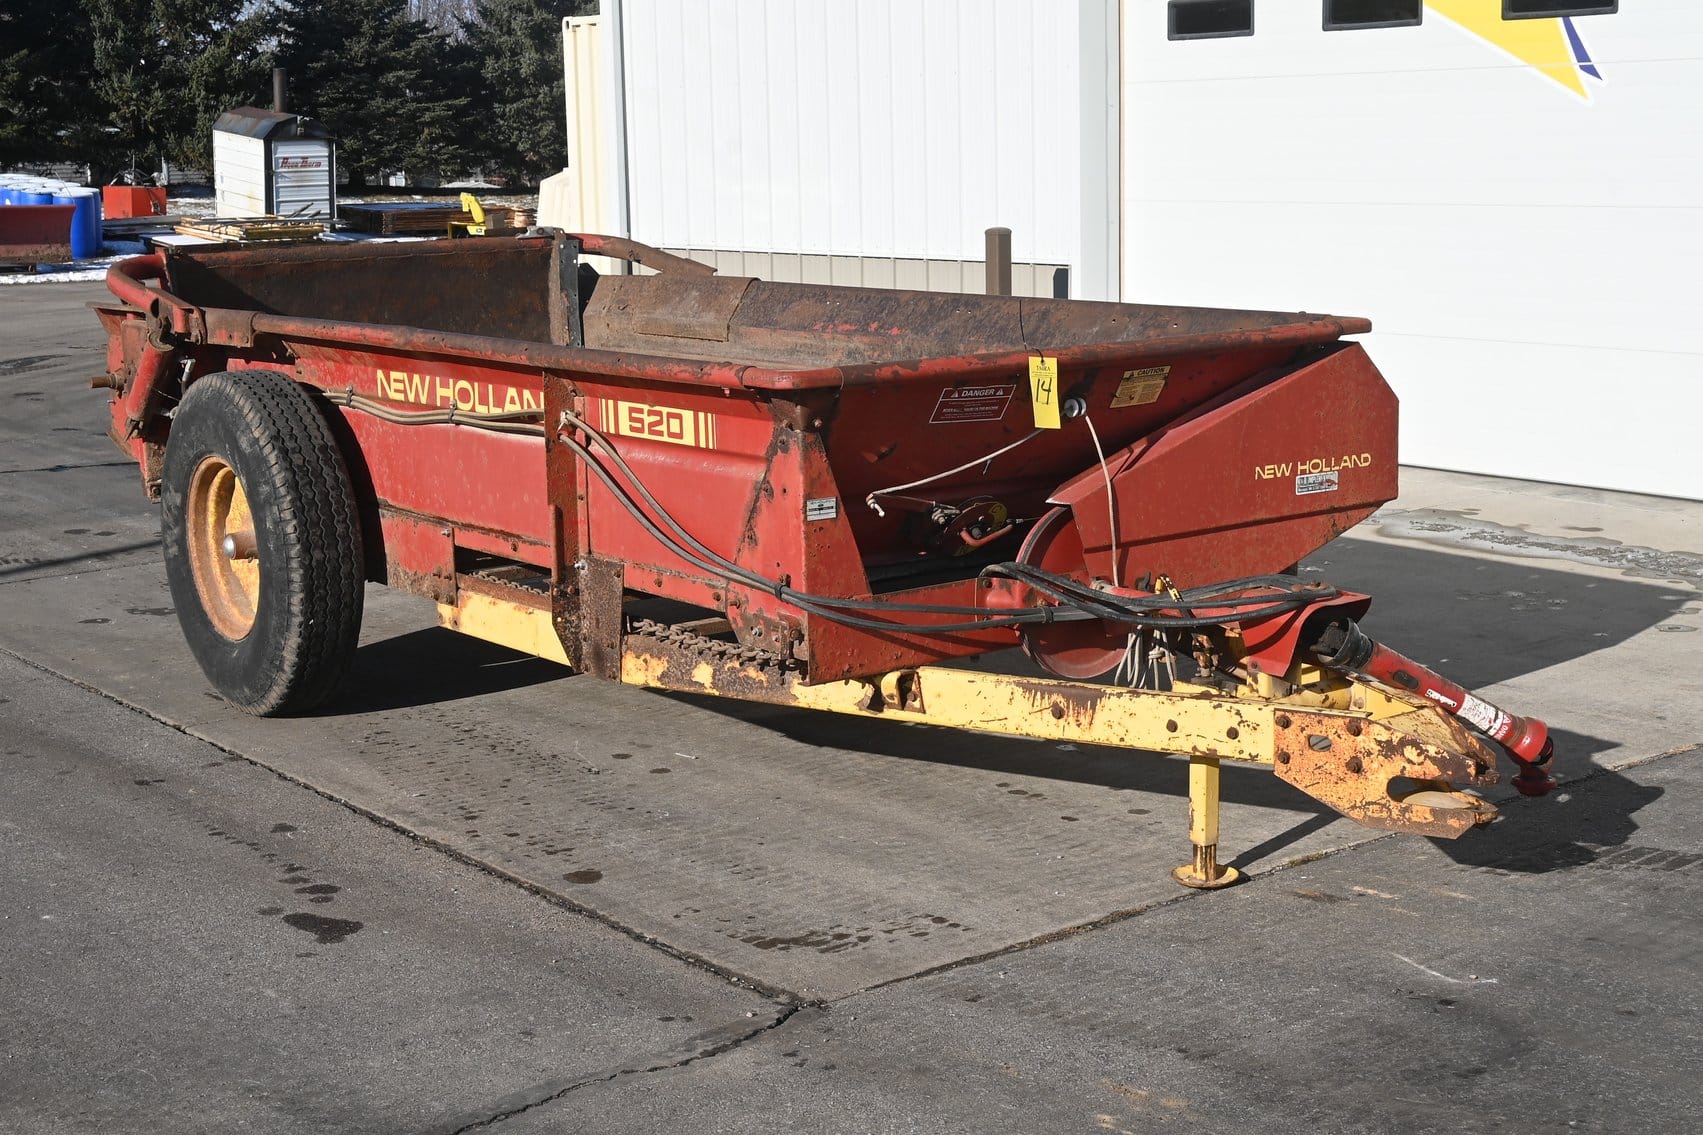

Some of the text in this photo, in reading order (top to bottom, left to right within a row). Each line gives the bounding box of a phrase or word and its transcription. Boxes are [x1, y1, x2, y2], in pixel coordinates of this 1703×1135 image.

[376, 369, 545, 415] NEW HOLLAN
[961, 388, 996, 397] DANGER
[1036, 377, 1052, 405] 14
[627, 406, 684, 440] 520
[1255, 453, 1372, 480] NEW HOLLAND
